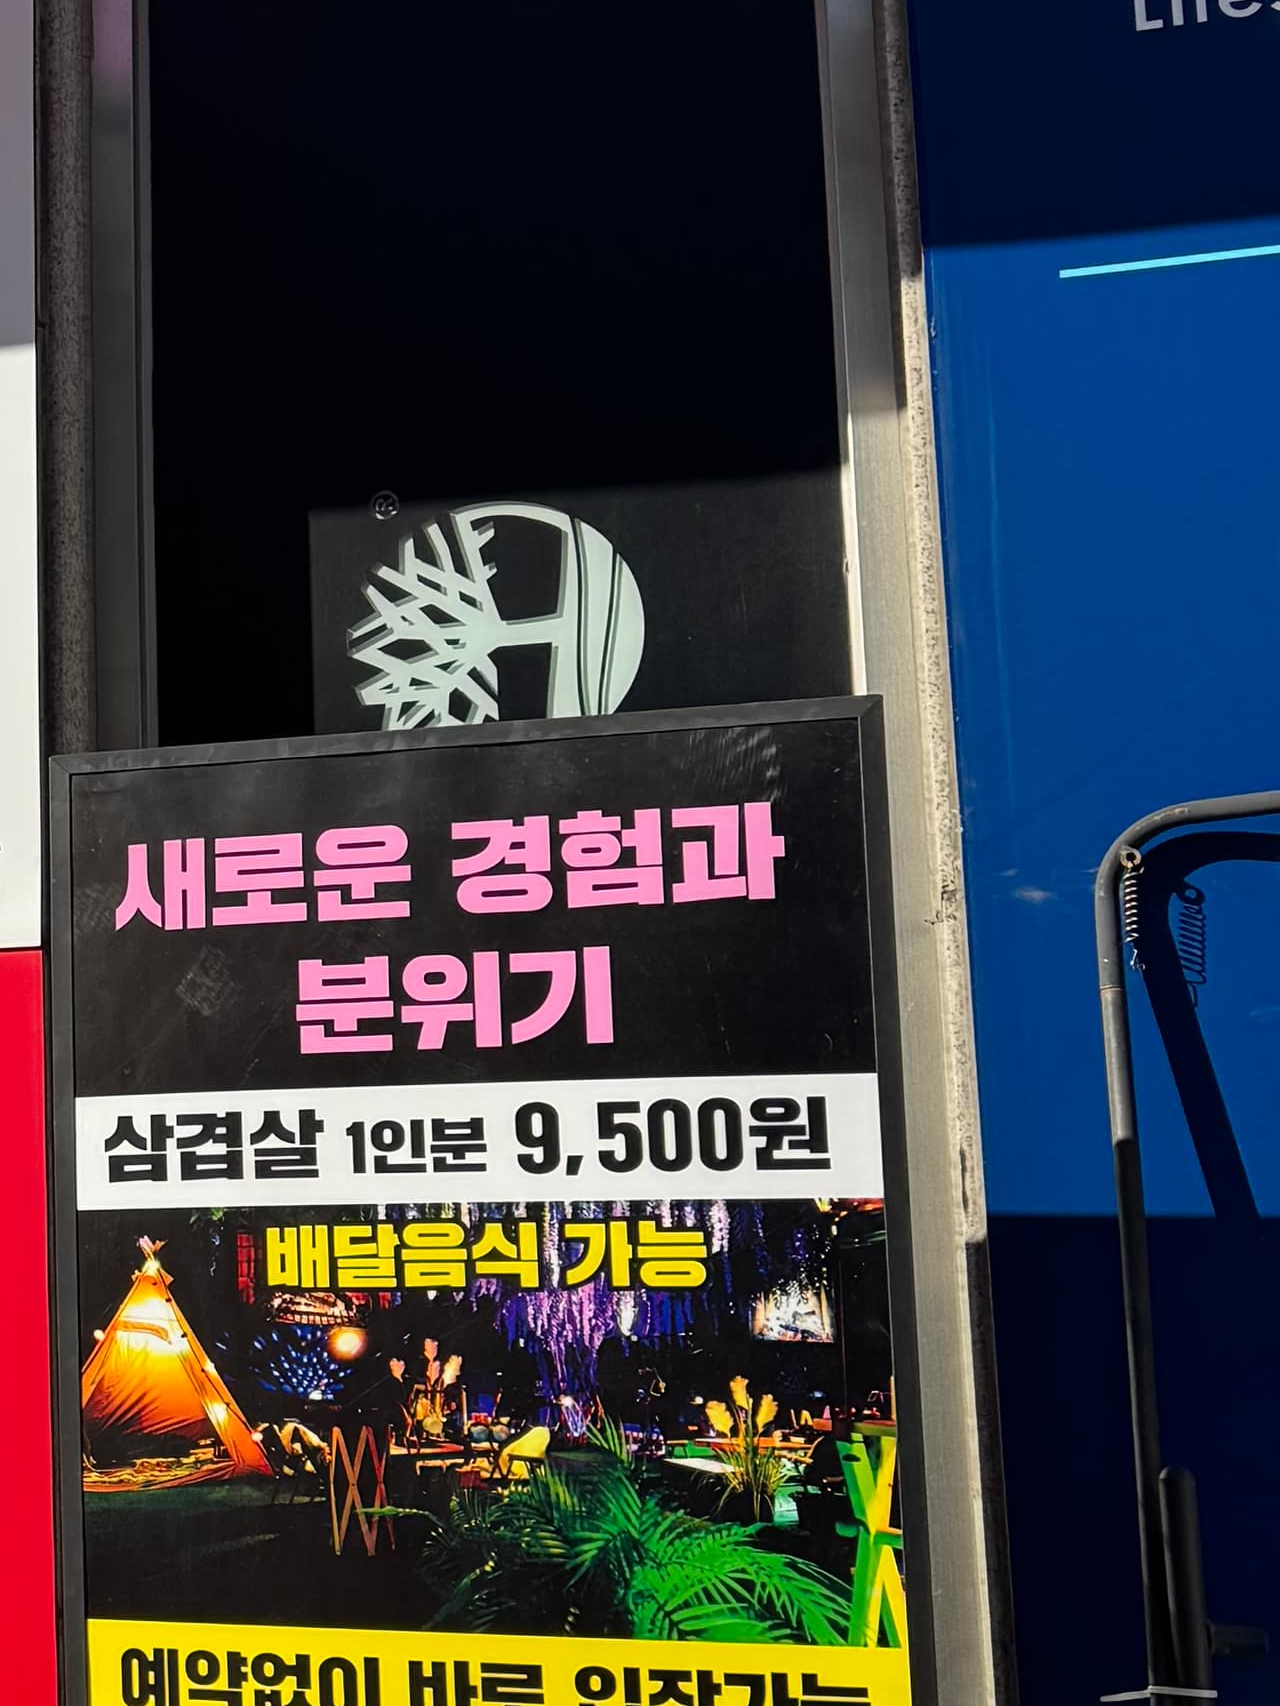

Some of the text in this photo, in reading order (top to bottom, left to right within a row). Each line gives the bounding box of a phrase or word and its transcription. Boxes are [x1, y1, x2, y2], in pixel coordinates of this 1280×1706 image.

[113, 803, 785, 931] 새로운 경험과
[295, 945, 615, 1054] 분위기
[102, 1097, 832, 1183] 삼겹살 1인분 9,500원
[265, 1220, 709, 1291] 배달음식 가능
